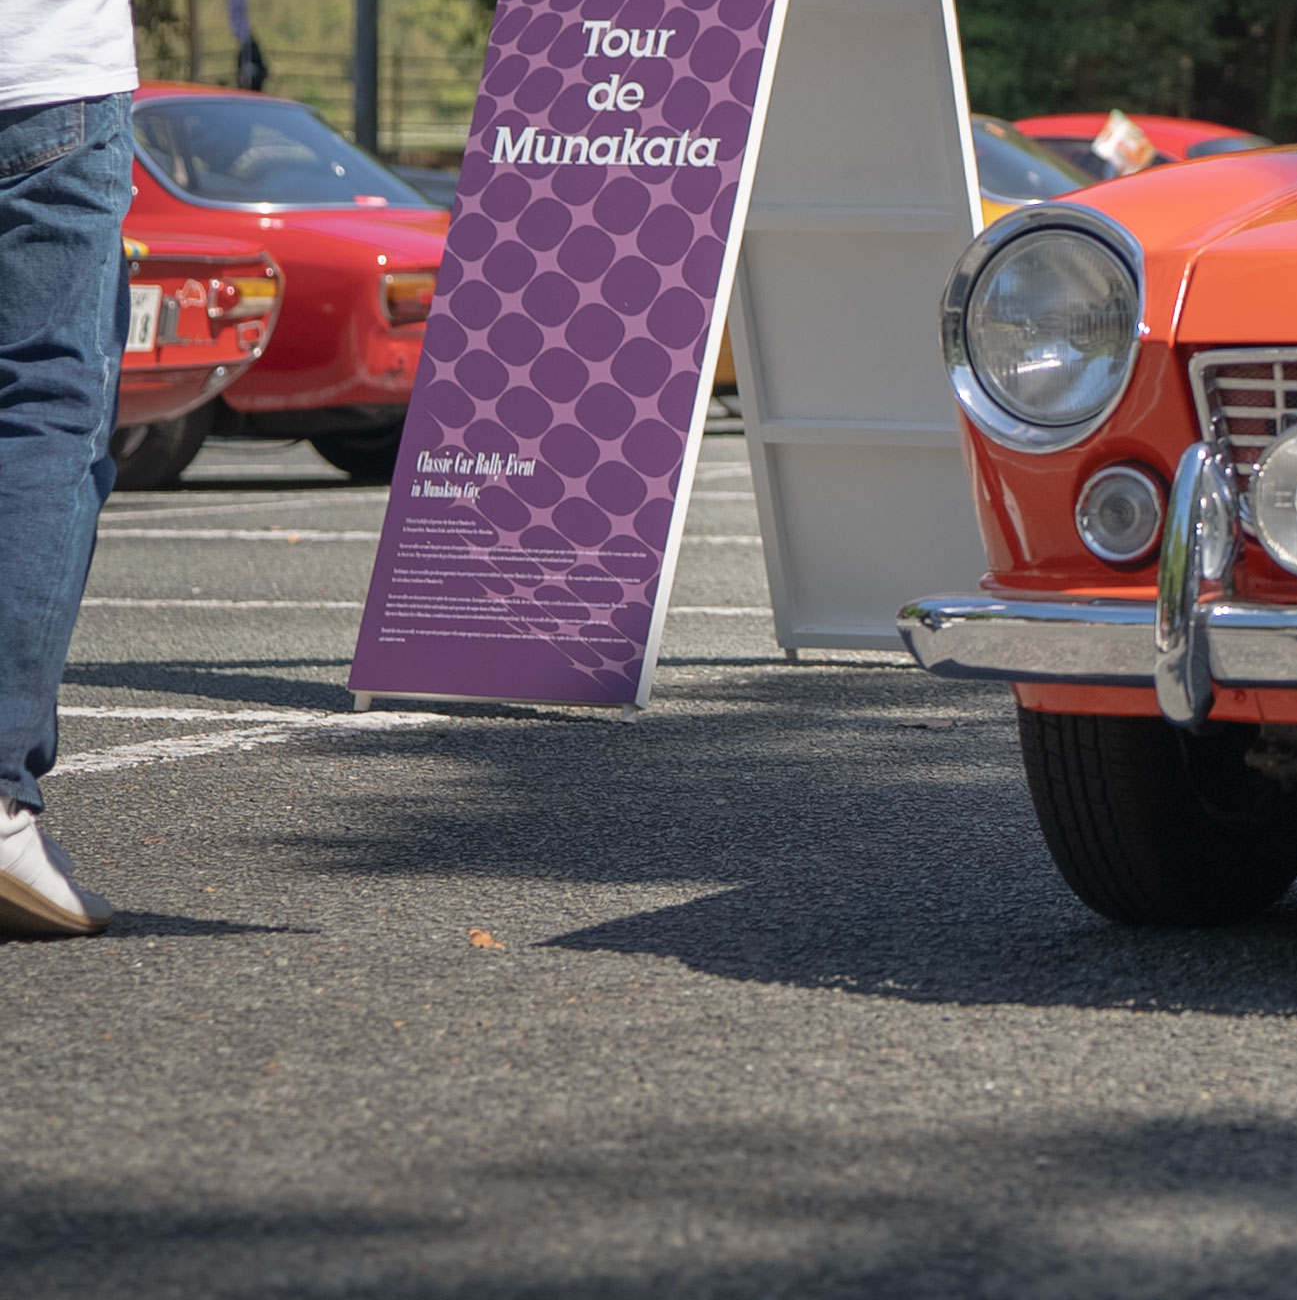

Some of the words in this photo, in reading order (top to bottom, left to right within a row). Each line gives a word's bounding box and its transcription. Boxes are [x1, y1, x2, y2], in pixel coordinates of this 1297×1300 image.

[582, 20, 676, 58] Tour
[586, 74, 645, 112] de
[488, 125, 721, 167] Munakata
[416, 450, 454, 474] Classic
[454, 451, 475, 475] Car
[475, 451, 505, 482] Rally
[505, 452, 537, 477] Event
[410, 479, 422, 498] in
[421, 479, 463, 499] Munakata
